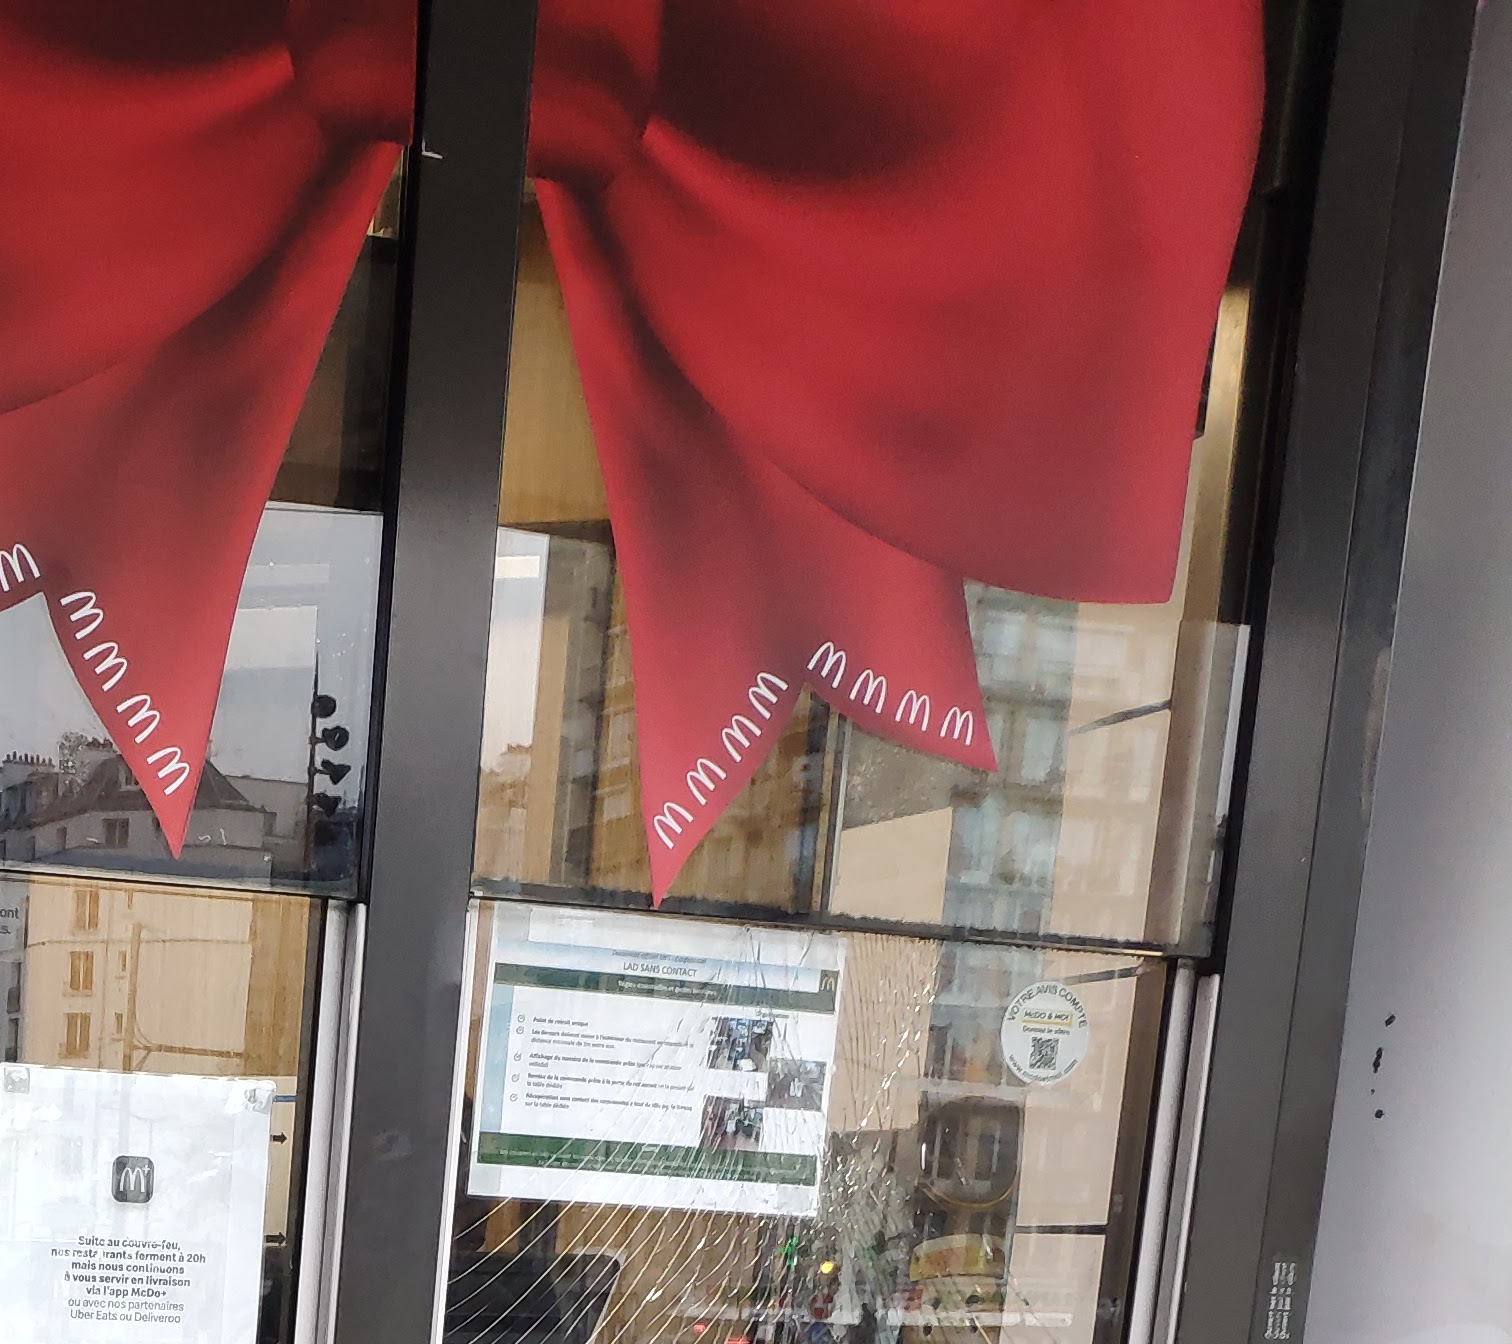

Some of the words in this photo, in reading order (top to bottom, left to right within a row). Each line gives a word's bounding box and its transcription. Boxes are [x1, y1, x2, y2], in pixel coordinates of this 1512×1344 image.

[623, 961, 639, 972] LAD
[640, 963, 660, 974] SANS
[661, 966, 698, 977] CONTACT
[1007, 988, 1035, 1021] VOTRE
[1058, 987, 1088, 1029] COMPTE
[78, 1235, 106, 1247] Suite
[107, 1238, 120, 1248] au
[51, 1248, 70, 1258] nos
[135, 1251, 177, 1263] ferment
[178, 1252, 185, 1263] à
[186, 1253, 206, 1263] 20h
[71, 1261, 97, 1271] mais
[98, 1263, 124, 1272] nous
[125, 1264, 185, 1275] continuons
[72, 1273, 97, 1283] vous
[99, 1273, 130, 1284] servir
[131, 1276, 144, 1285] en
[145, 1275, 191, 1287] livraison
[85, 1284, 101, 1296] via
[103, 1286, 129, 1299] l'app
[131, 1288, 167, 1298] McDo+
[68, 1298, 81, 1307] ou
[82, 1299, 107, 1308] avec
[108, 1301, 127, 1309] nos
[128, 1301, 185, 1313] partenaires
[70, 1309, 95, 1320] Uber
[96, 1311, 118, 1321] Eats
[119, 1313, 132, 1321] ou
[134, 1312, 181, 1324] Deliveroo
